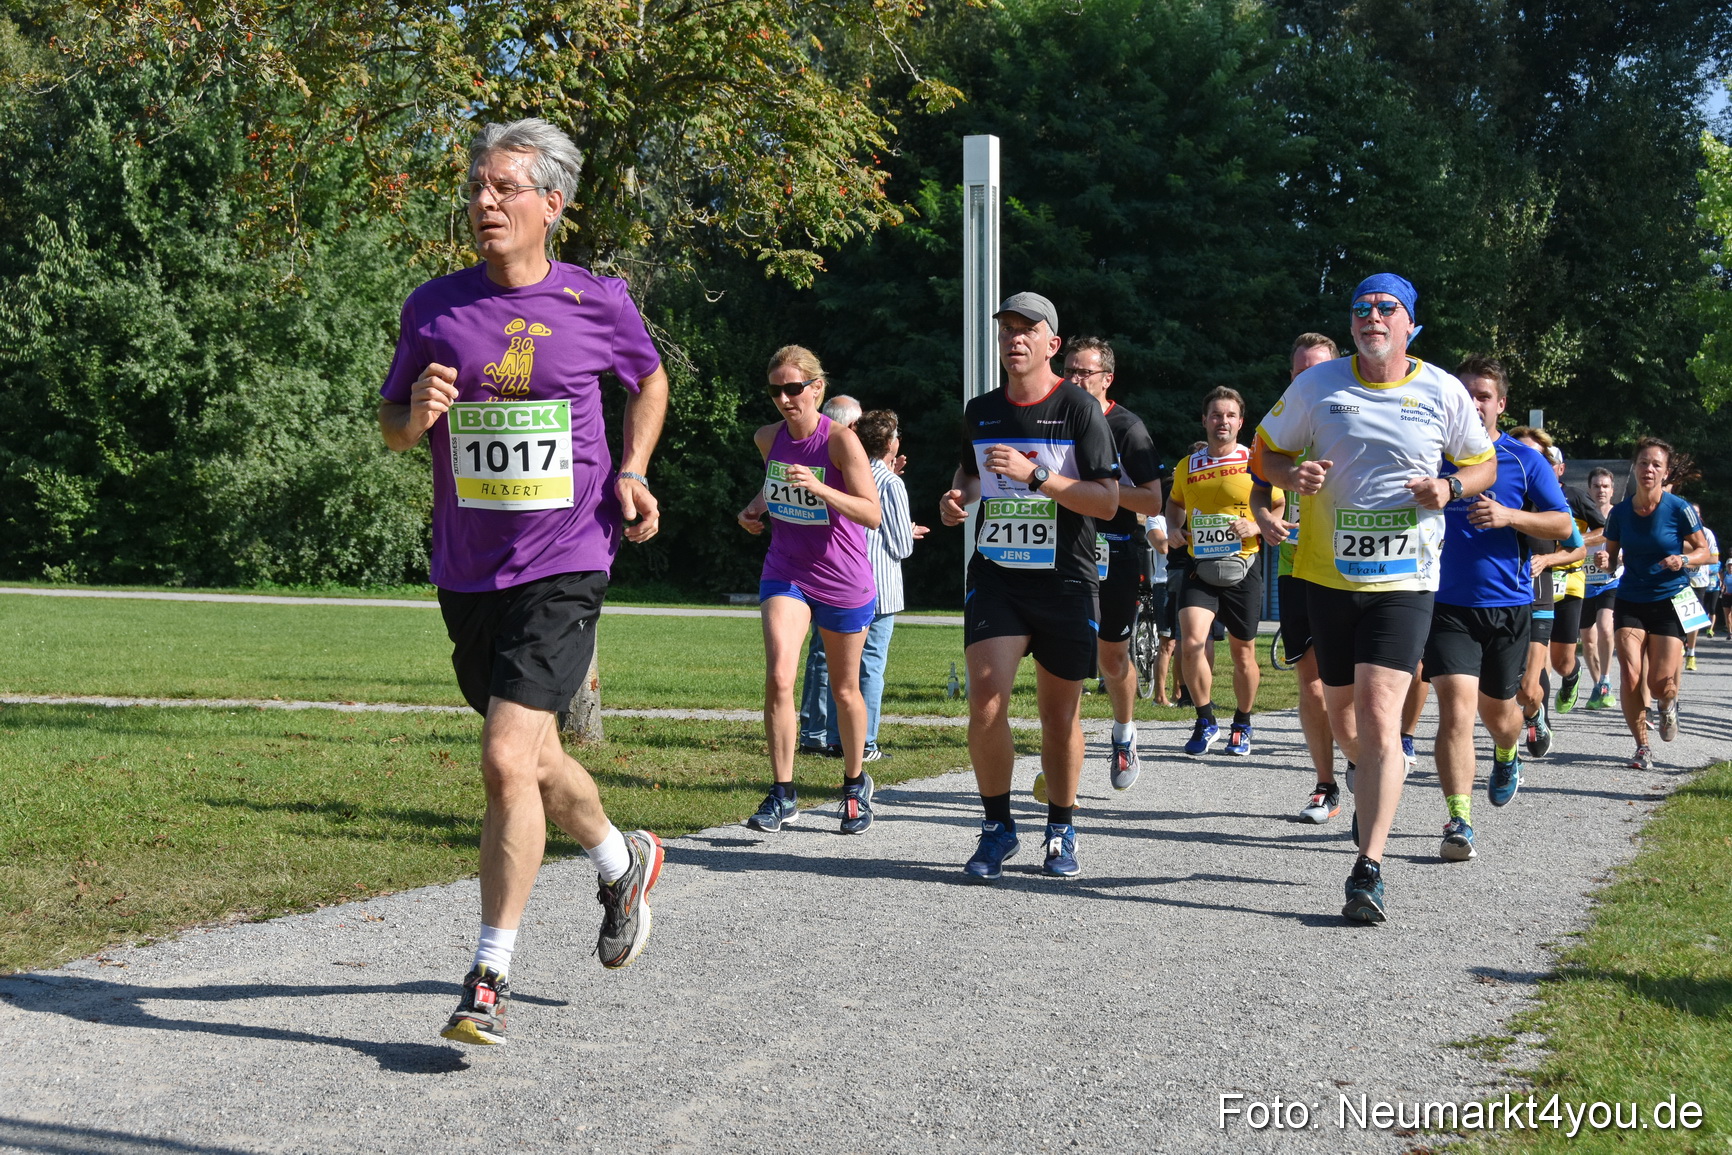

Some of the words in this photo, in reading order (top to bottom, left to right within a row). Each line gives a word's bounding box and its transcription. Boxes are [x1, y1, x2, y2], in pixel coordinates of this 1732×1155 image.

[1330, 404, 1360, 412] BOCK
[457, 405, 560, 430] BOCK
[465, 439, 557, 473] 1017
[1187, 471, 1216, 484] MAX
[481, 484, 543, 496] ALBERT
[770, 483, 818, 507] 2118
[777, 505, 815, 519] CARMEN
[989, 501, 1050, 517] BOCK
[1194, 515, 1231, 527] BOCK
[1341, 511, 1411, 529] BOCK
[986, 523, 1048, 545] 2119
[1196, 529, 1236, 544] 2406
[1203, 545, 1230, 554] MARCO
[1342, 534, 1409, 557] 2817
[1000, 551, 1031, 560] JENS
[1348, 562, 1387, 575] Frank
